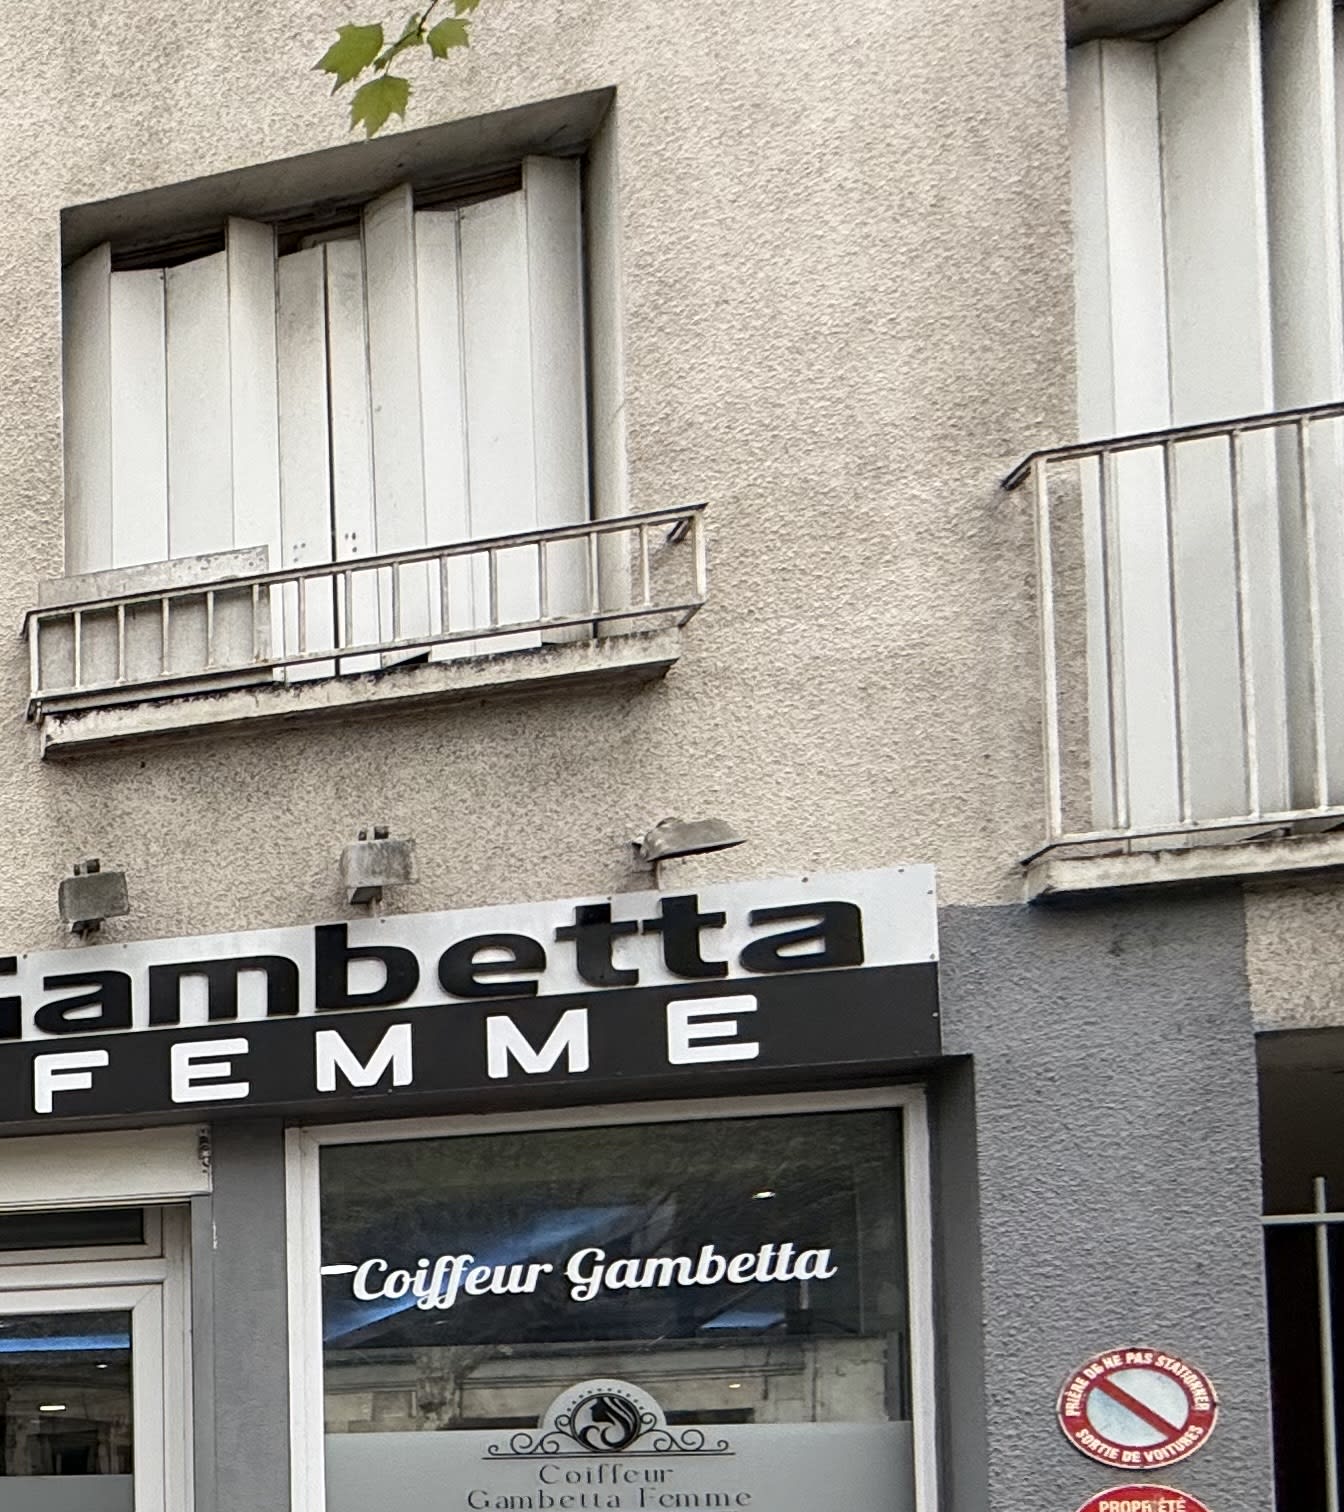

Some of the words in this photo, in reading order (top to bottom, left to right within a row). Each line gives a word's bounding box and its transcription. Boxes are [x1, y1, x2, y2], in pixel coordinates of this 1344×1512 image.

[33, 994, 761, 1115] FEMME
[353, 1255, 553, 1310] Coiffeur
[564, 1243, 839, 1301] Gambetta
[1083, 1363, 1105, 1379] DE
[1125, 1352, 1153, 1364] PAS
[1075, 1428, 1120, 1459] SORTIE
[1121, 1450, 1142, 1463] DE
[1143, 1425, 1204, 1462] VOITURES
[538, 1463, 674, 1484] Coiffeur
[467, 1489, 620, 1510] Gambetta
[639, 1487, 752, 1508] Femme
